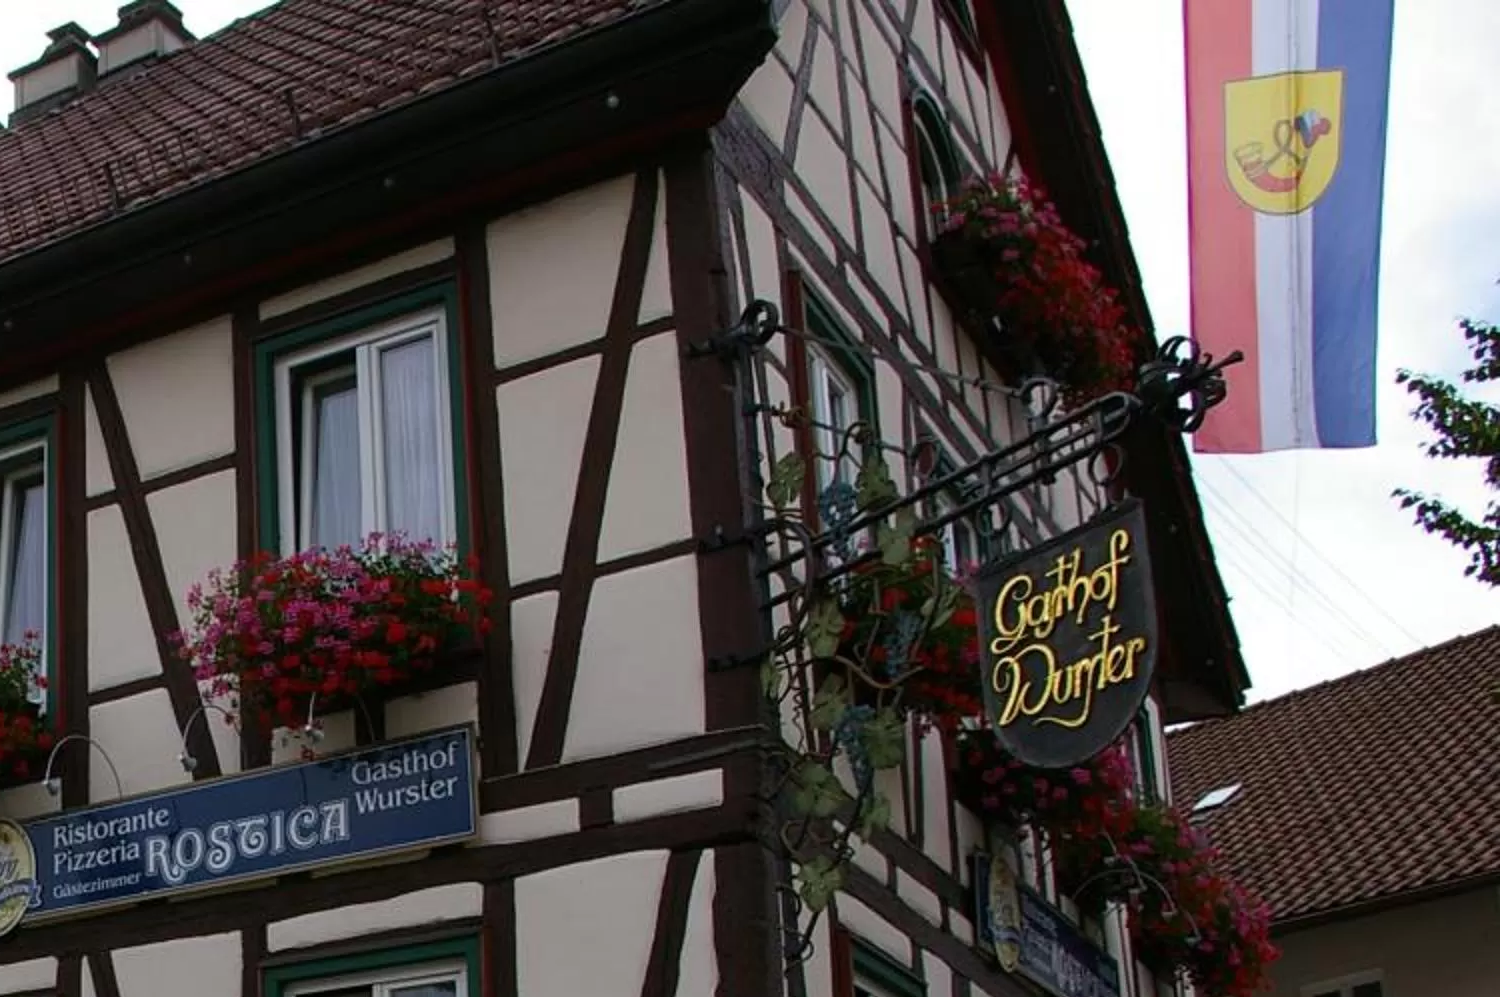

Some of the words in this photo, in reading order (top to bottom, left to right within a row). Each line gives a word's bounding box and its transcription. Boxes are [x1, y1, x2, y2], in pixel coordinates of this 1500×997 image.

[351, 741, 459, 785] Gasthof
[355, 775, 459, 815] Wurster
[53, 806, 170, 848] Ristorante
[145, 798, 350, 886] ROSTICA
[53, 839, 141, 875] Pizzeria
[52, 871, 142, 898] Gästezimmer
